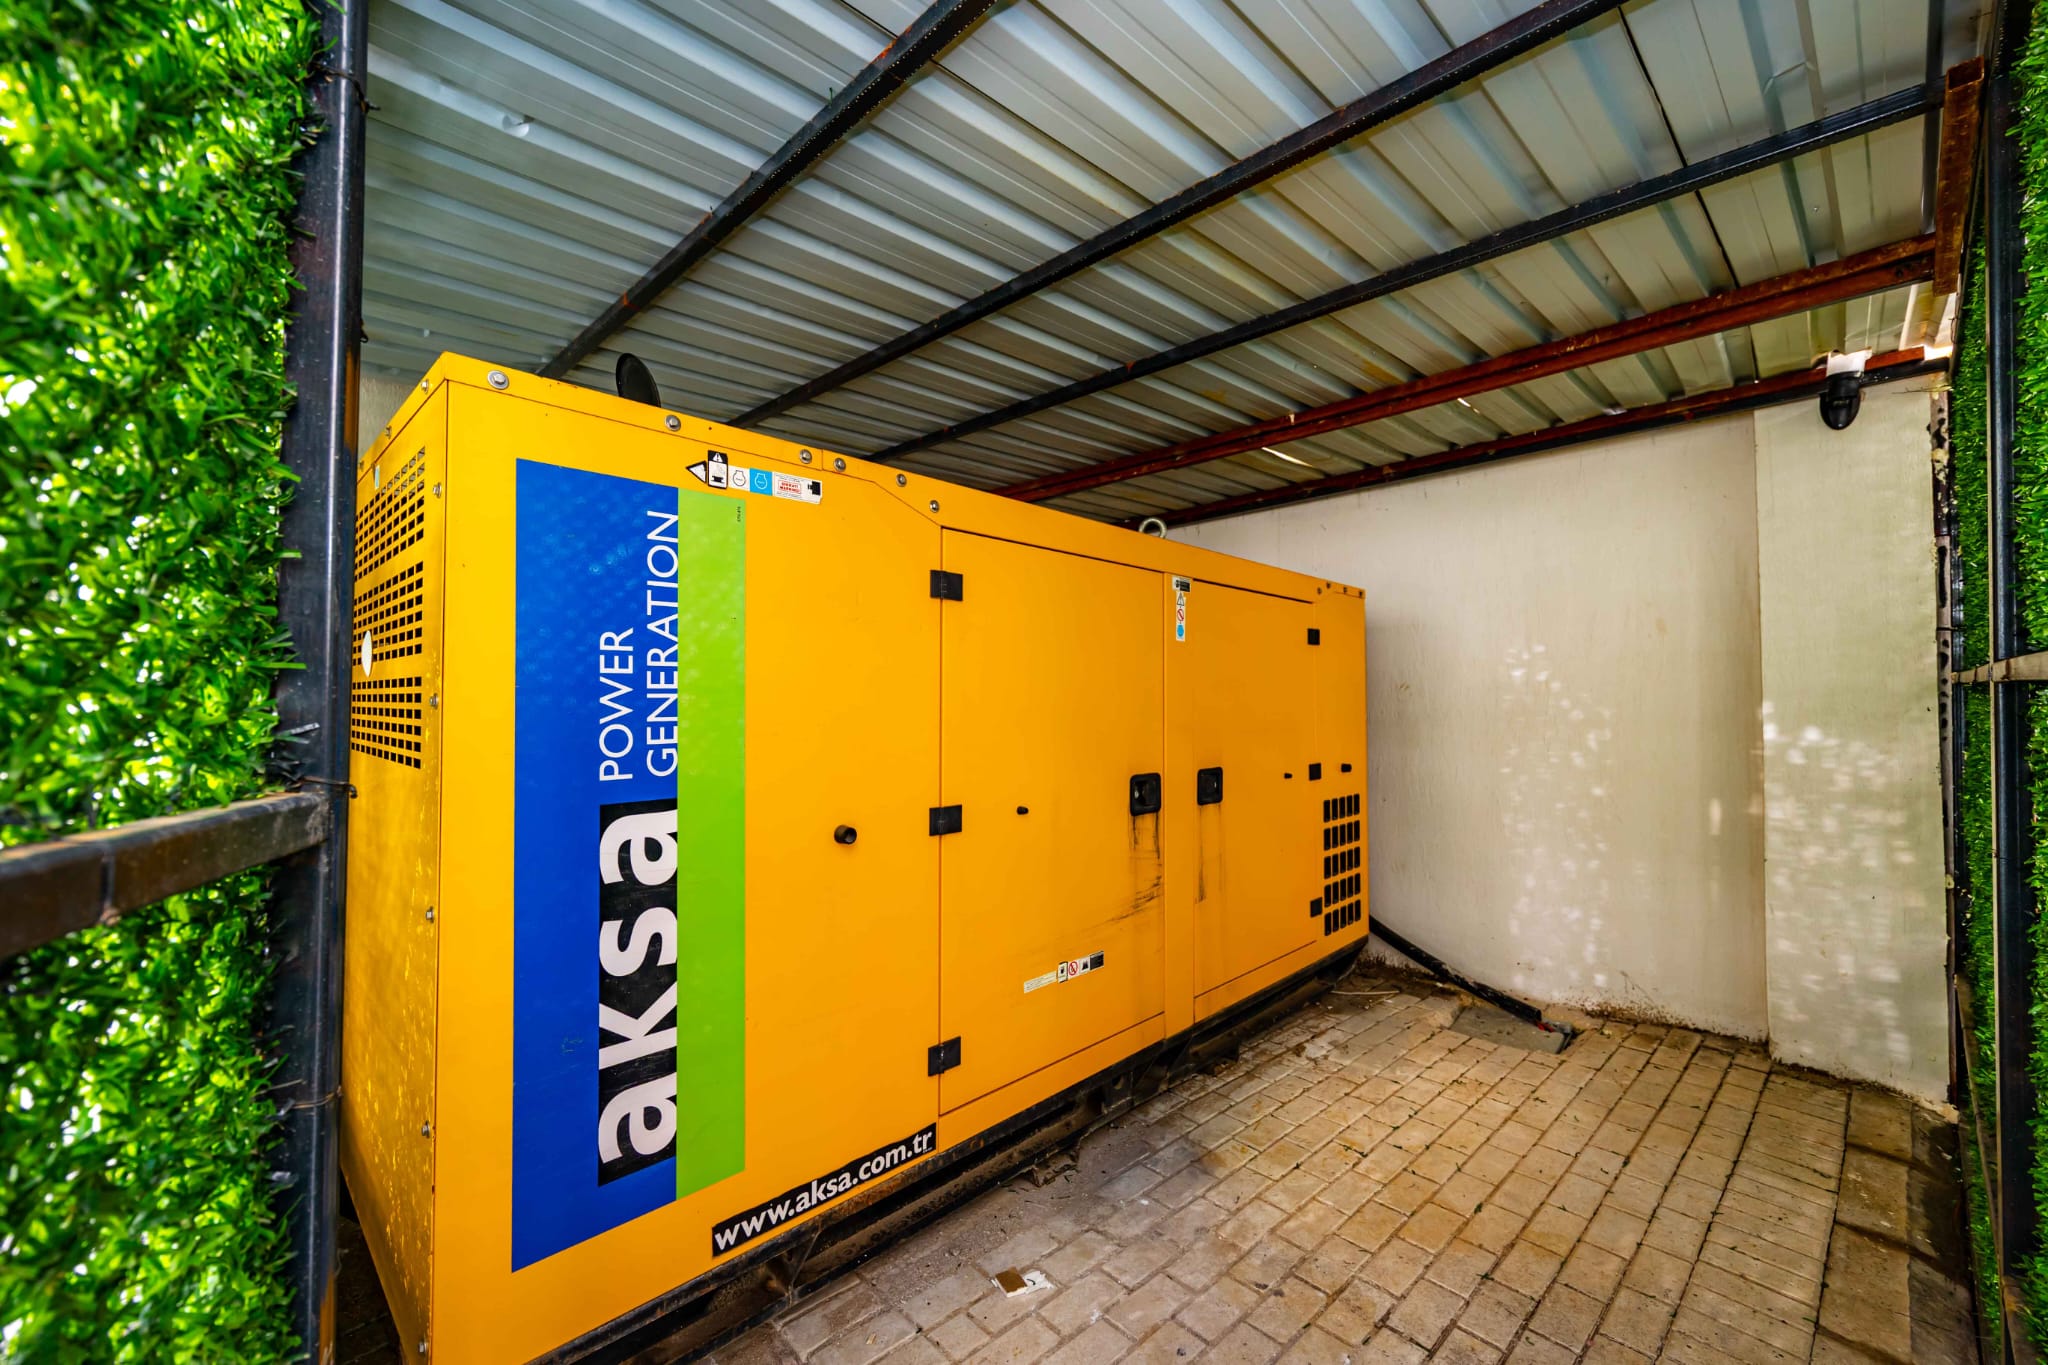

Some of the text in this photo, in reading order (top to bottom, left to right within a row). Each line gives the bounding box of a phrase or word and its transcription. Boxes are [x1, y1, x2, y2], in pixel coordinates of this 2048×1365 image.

[599, 627, 634, 781] POWER
[646, 510, 679, 777] GENERATION
[714, 1131, 933, 1251] www.aksa.com.tr
